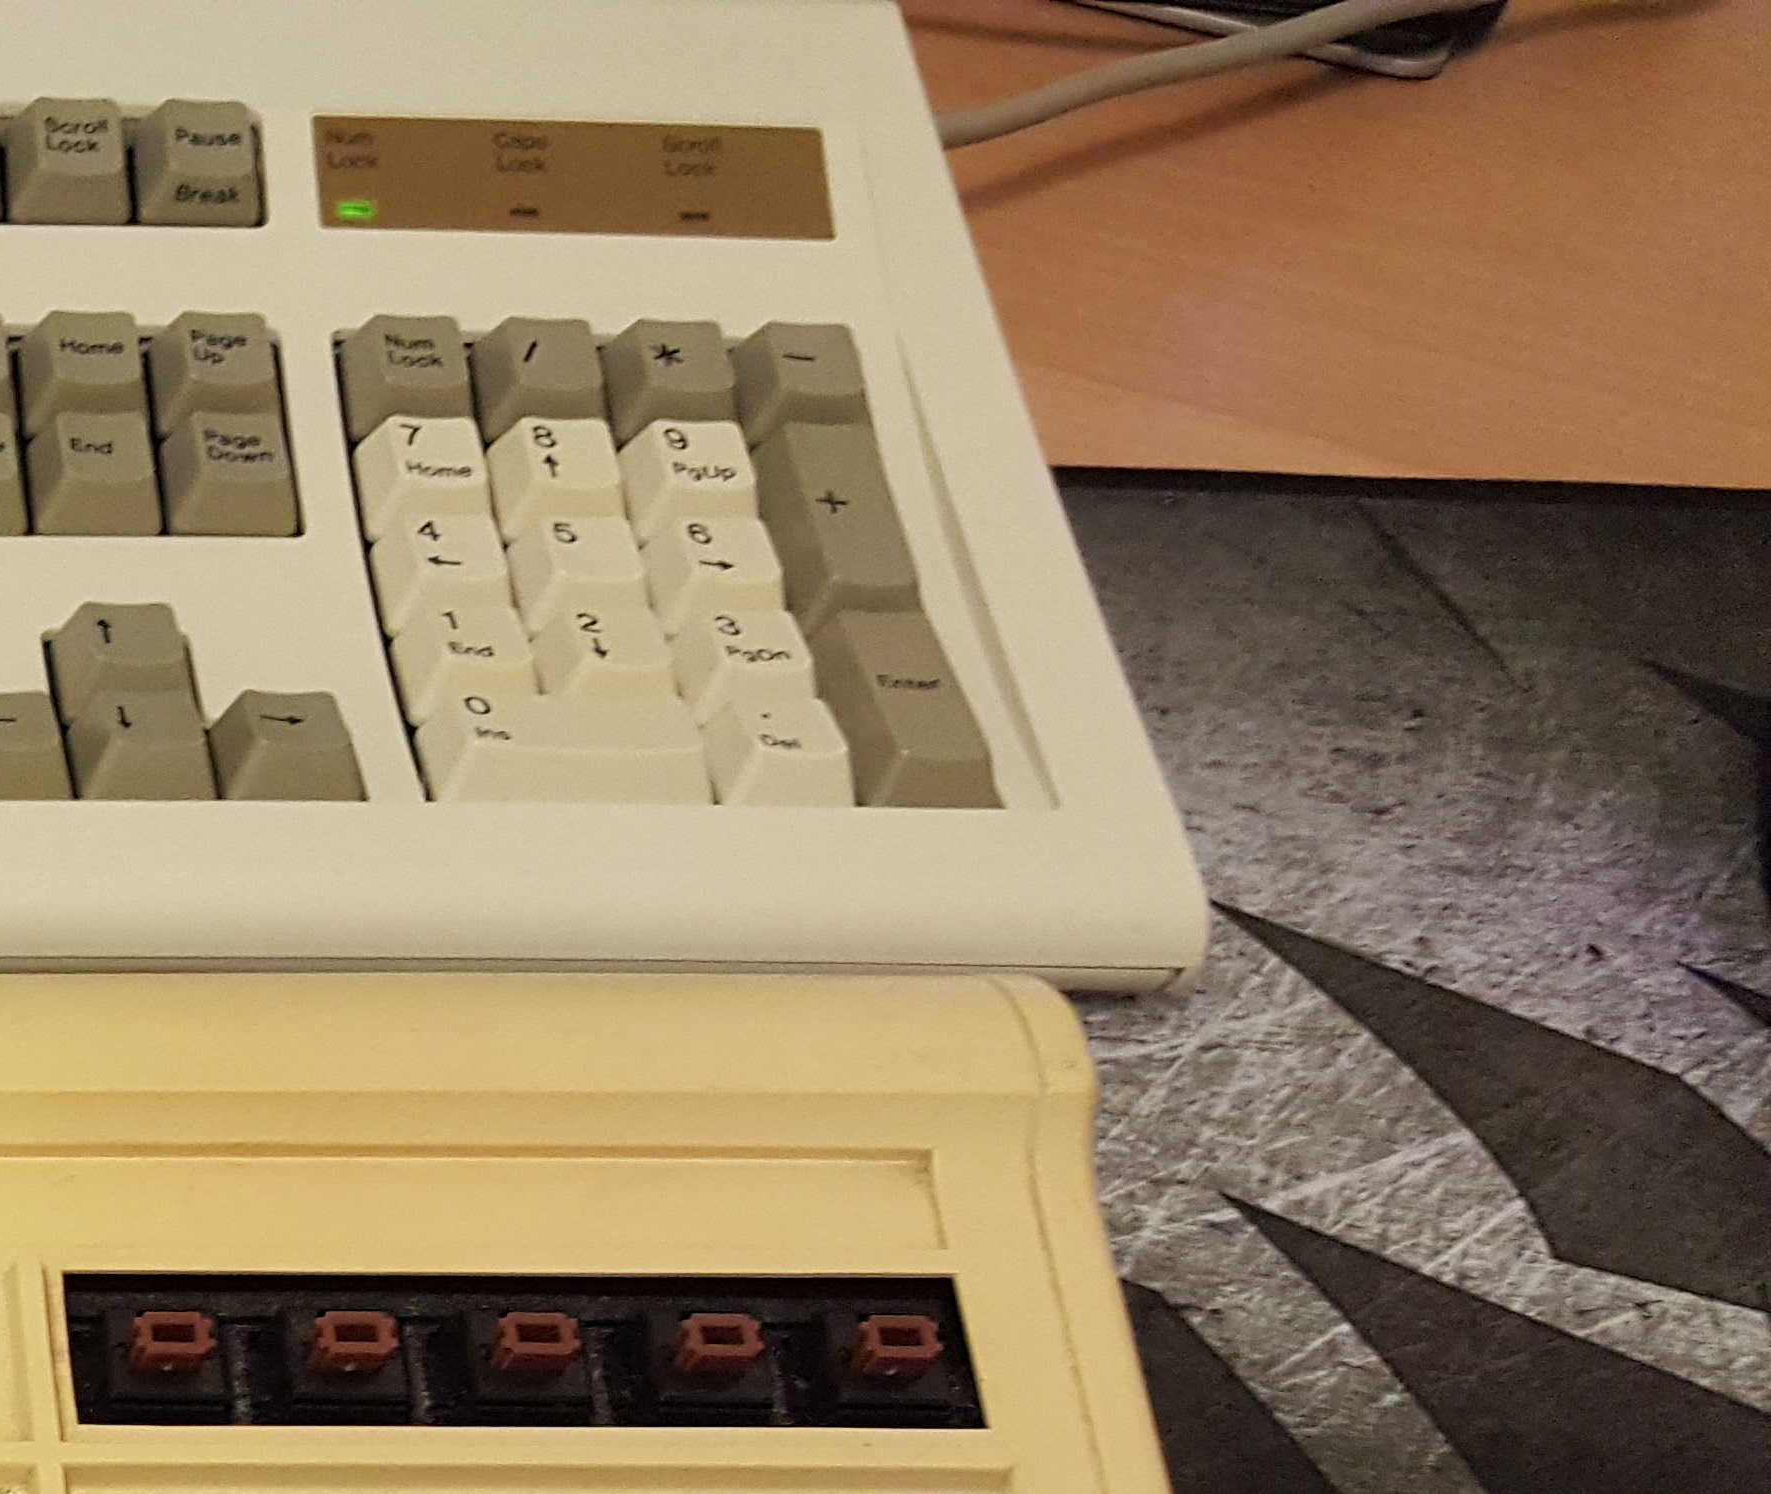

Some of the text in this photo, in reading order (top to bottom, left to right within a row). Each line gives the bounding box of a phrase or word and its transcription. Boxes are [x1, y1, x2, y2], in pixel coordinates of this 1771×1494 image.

[45, 116, 108, 134] Scroll
[45, 134, 100, 153] Lock
[175, 128, 240, 146] Pause
[326, 130, 374, 145] Num
[493, 132, 548, 150] Caps
[326, 152, 378, 169] Lock
[496, 155, 544, 172] Lock
[665, 160, 715, 176] Lock
[176, 184, 239, 203] Break
[61, 338, 124, 355] Home
[191, 329, 247, 347] Page
[385, 333, 435, 350] Num
[193, 349, 224, 366] Up
[386, 351, 442, 368] Lock
[203, 429, 259, 447] Page
[400, 424, 420, 445] 7
[532, 425, 557, 447] 8
[663, 428, 687, 449] 9
[70, 437, 113, 455] End
[207, 446, 273, 463] Down
[406, 461, 471, 477] Home
[673, 461, 735, 481] PgUp
[417, 521, 442, 540] 4
[553, 522, 577, 543] 5
[687, 523, 712, 544] 6
[443, 610, 457, 629] 1
[575, 613, 602, 633] 2
[714, 616, 740, 635] 3
[877, 675, 940, 691] Enter
